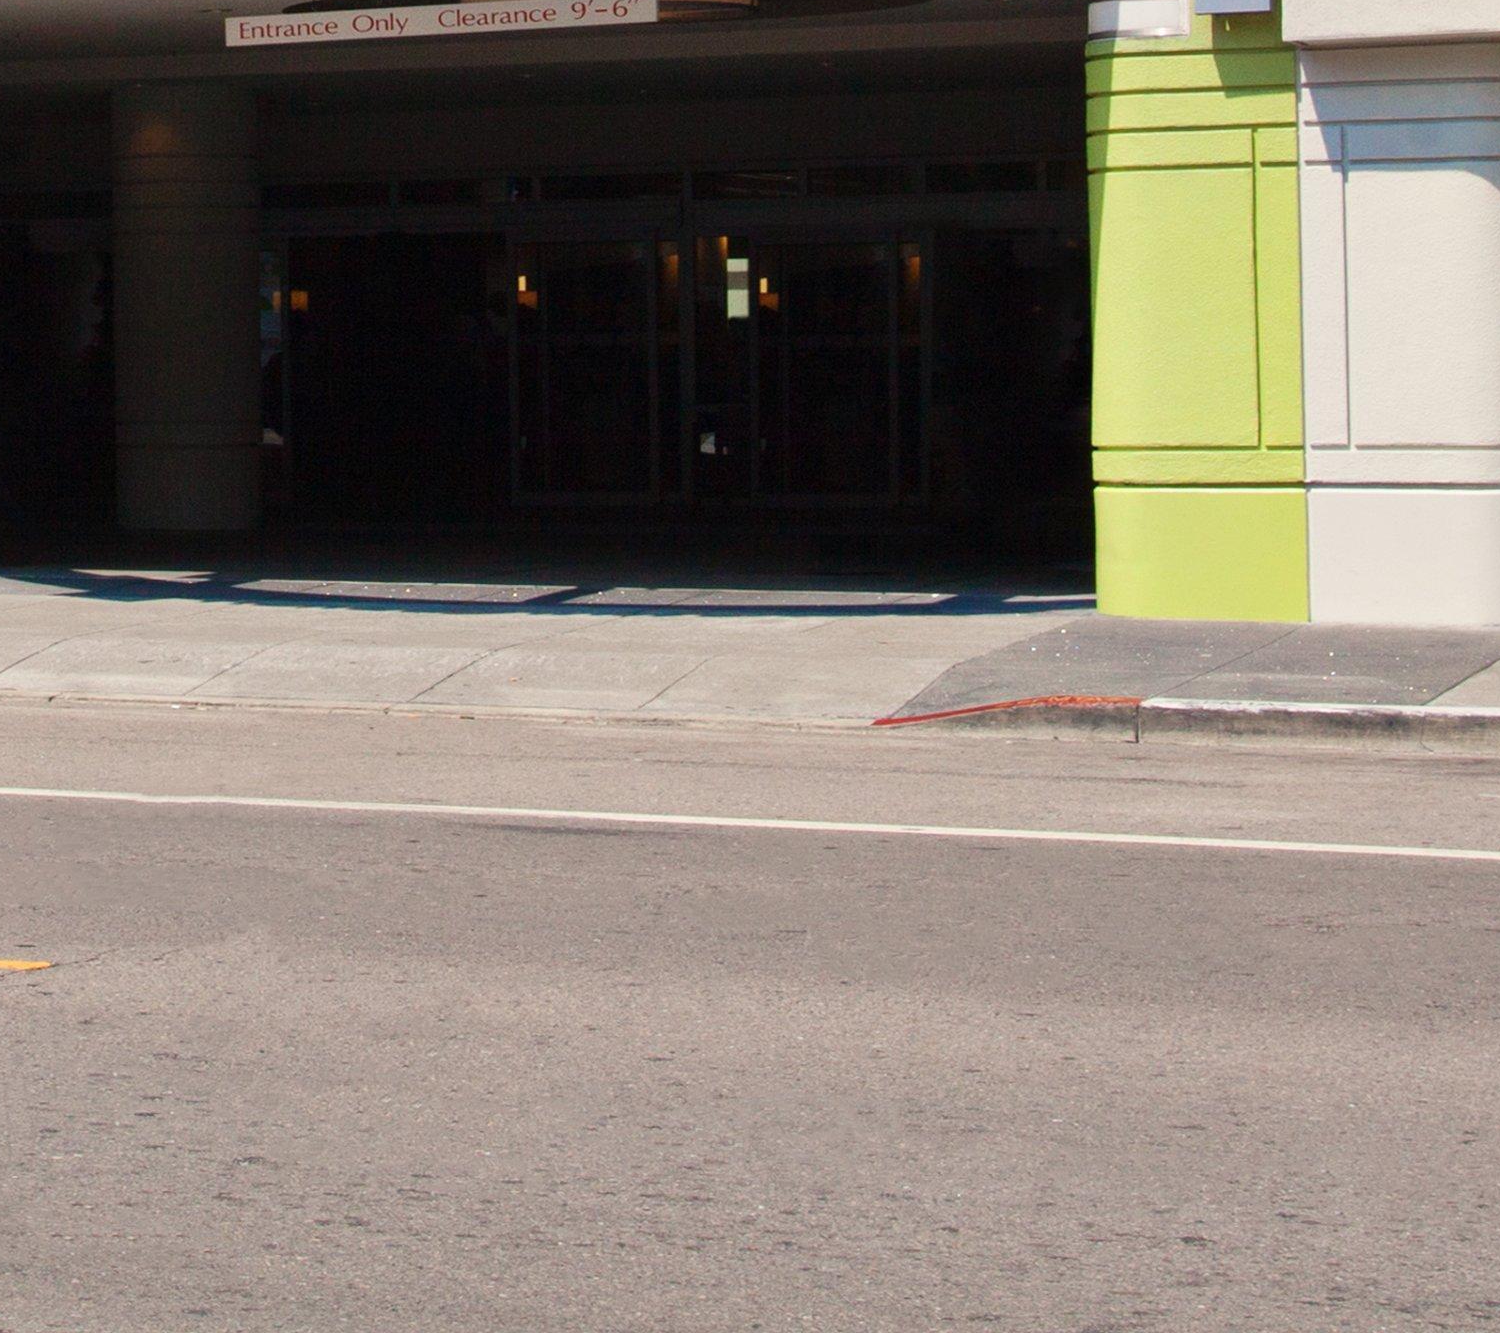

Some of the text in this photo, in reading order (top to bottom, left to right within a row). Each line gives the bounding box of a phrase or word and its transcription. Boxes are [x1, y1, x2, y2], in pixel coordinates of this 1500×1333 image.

[239, 20, 339, 40] Entrance
[352, 12, 409, 34] Only
[438, 6, 557, 28] Clearance
